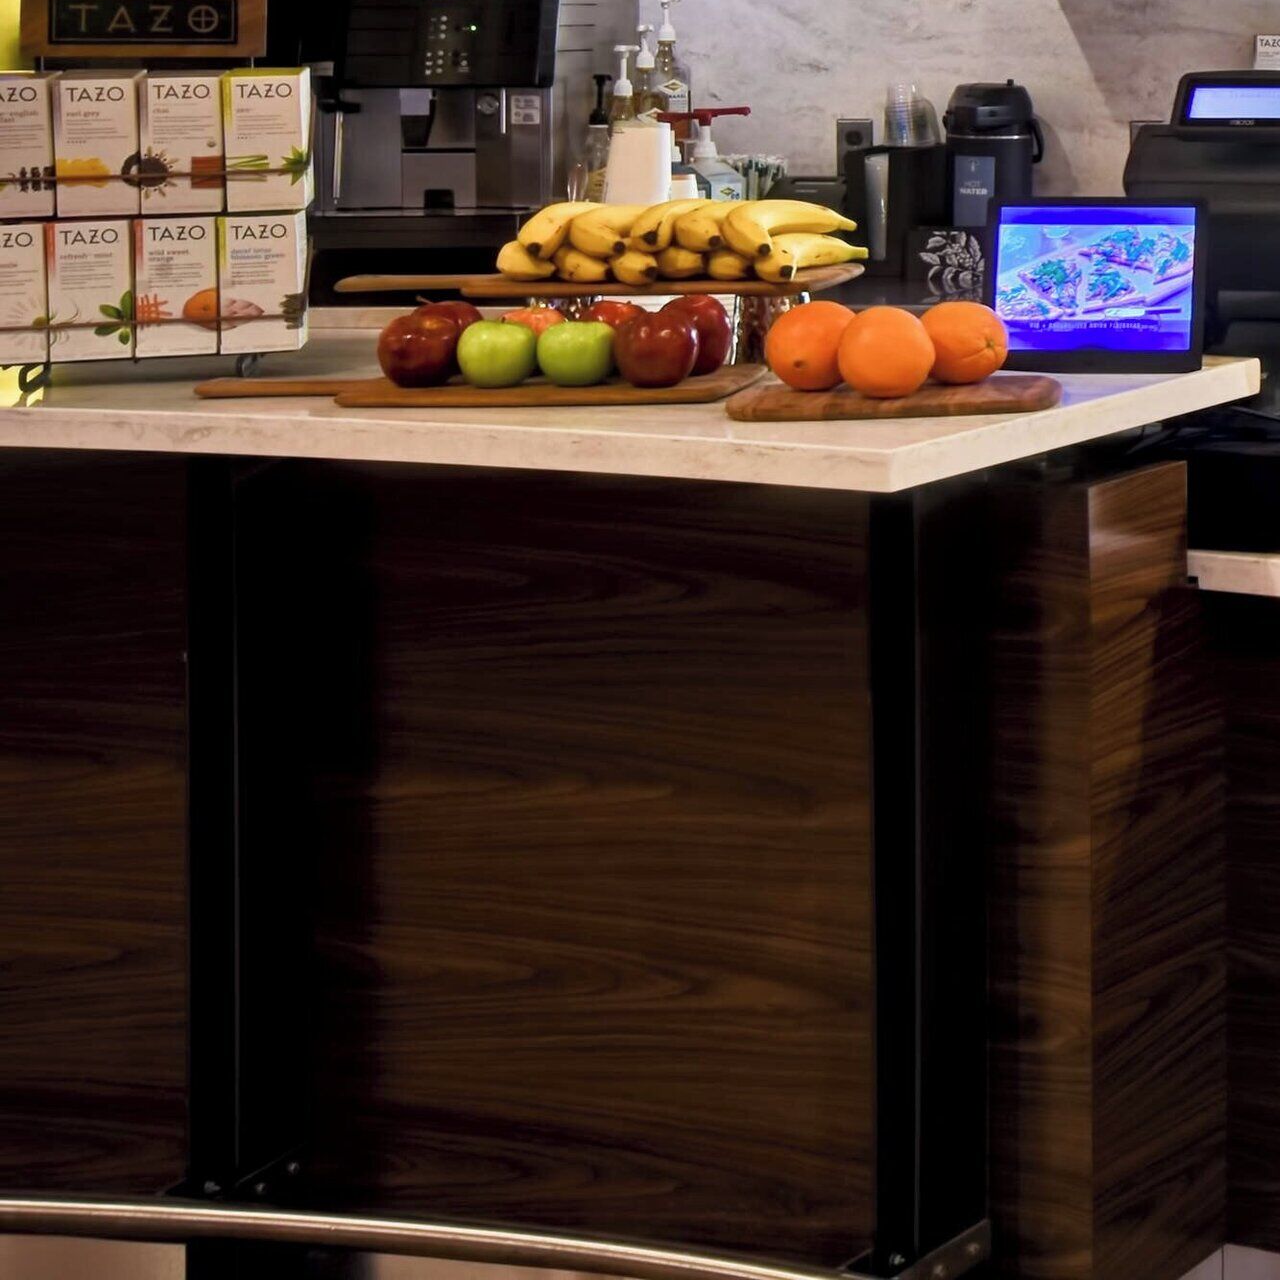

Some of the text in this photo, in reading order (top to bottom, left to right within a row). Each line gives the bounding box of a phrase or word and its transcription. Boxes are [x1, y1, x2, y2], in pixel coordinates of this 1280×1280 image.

[68, 4, 220, 33] TAZO
[66, 86, 125, 102] TAZO
[153, 84, 211, 100] TAZO
[236, 82, 293, 98] TAZO
[60, 228, 119, 245] TAZO
[148, 225, 206, 240] TAZO
[230, 223, 288, 239] TAZO
